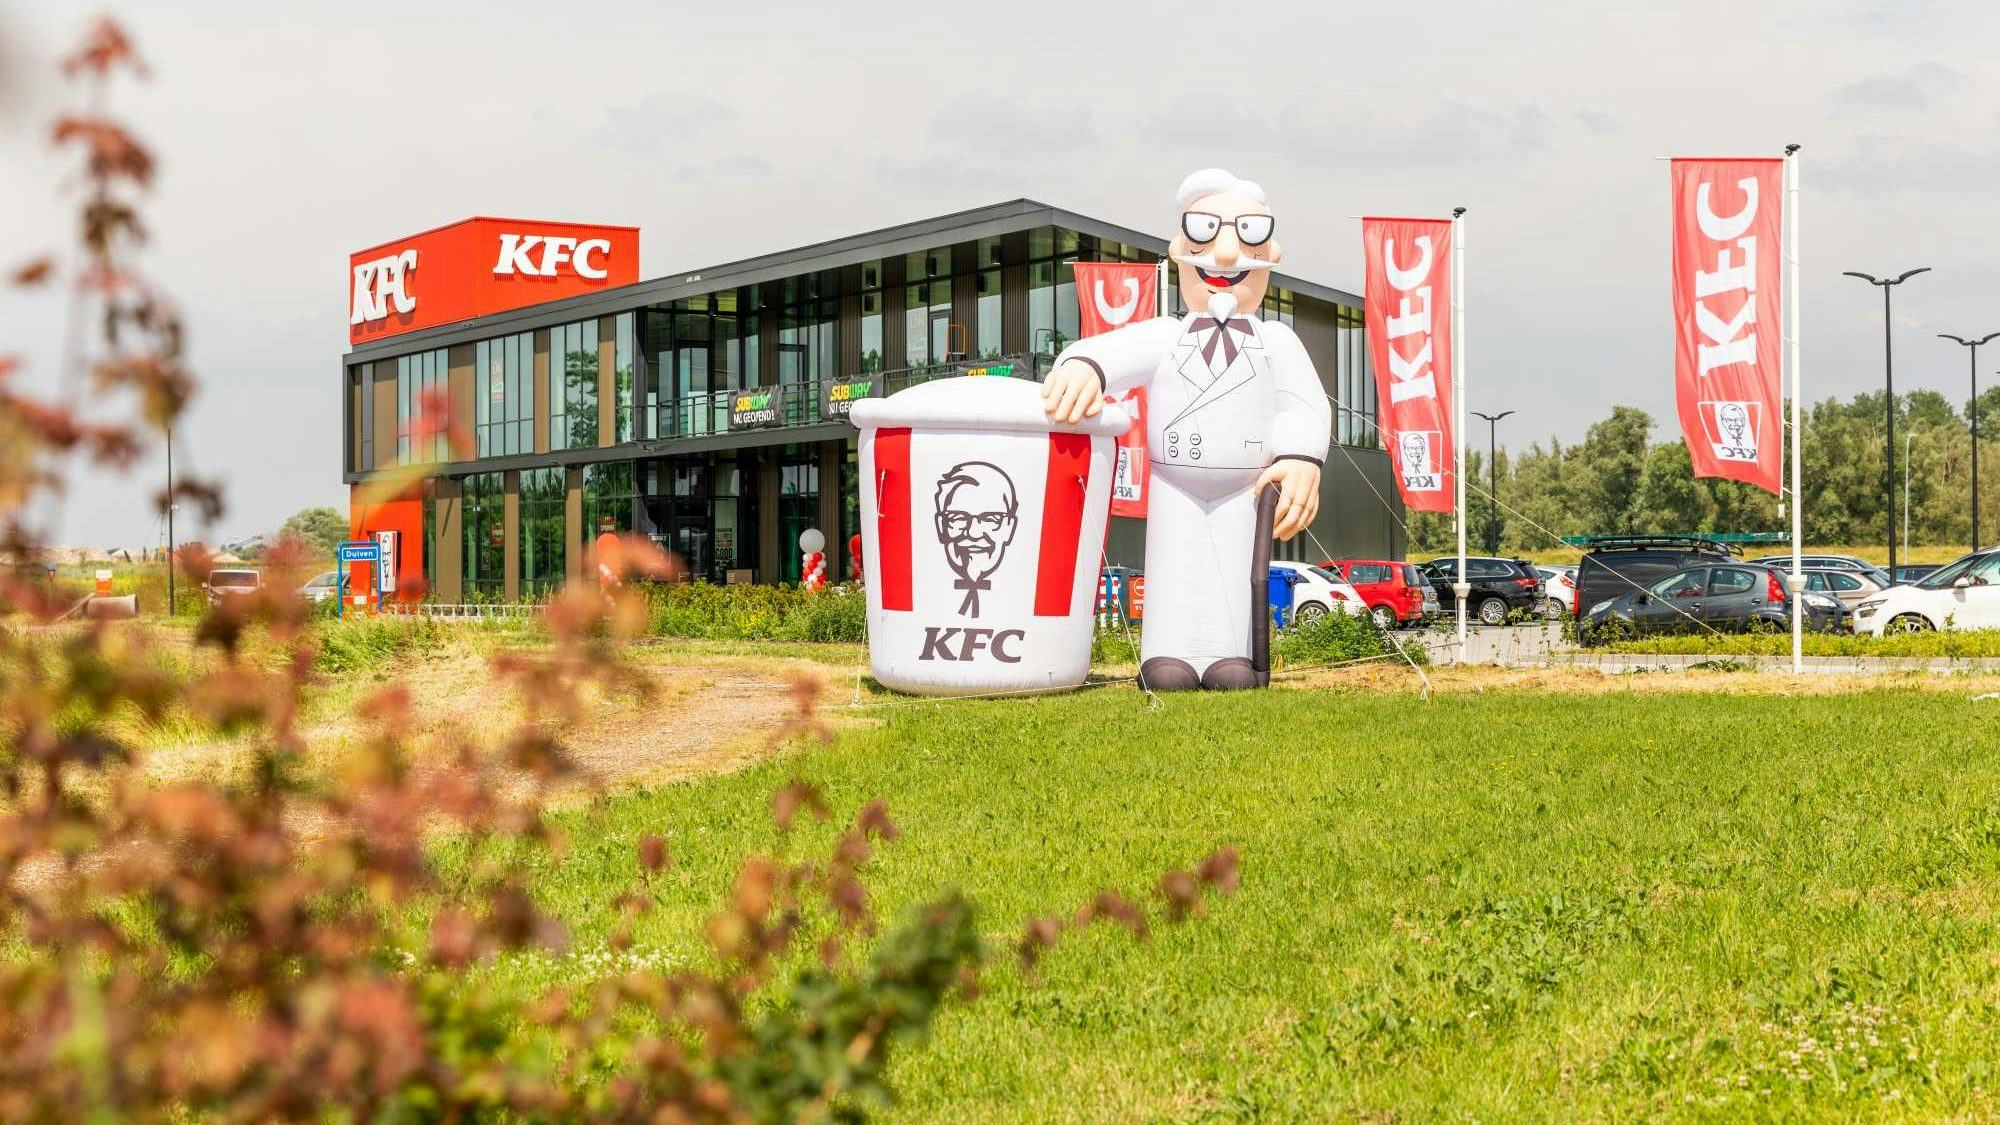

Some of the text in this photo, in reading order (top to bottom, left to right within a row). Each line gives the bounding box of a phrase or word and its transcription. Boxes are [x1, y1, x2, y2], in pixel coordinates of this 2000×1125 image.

[493, 234, 611, 279] KFC
[350, 249, 418, 325] KFC
[830, 381, 872, 401] SUBWAY
[918, 627, 1025, 663] KFC
